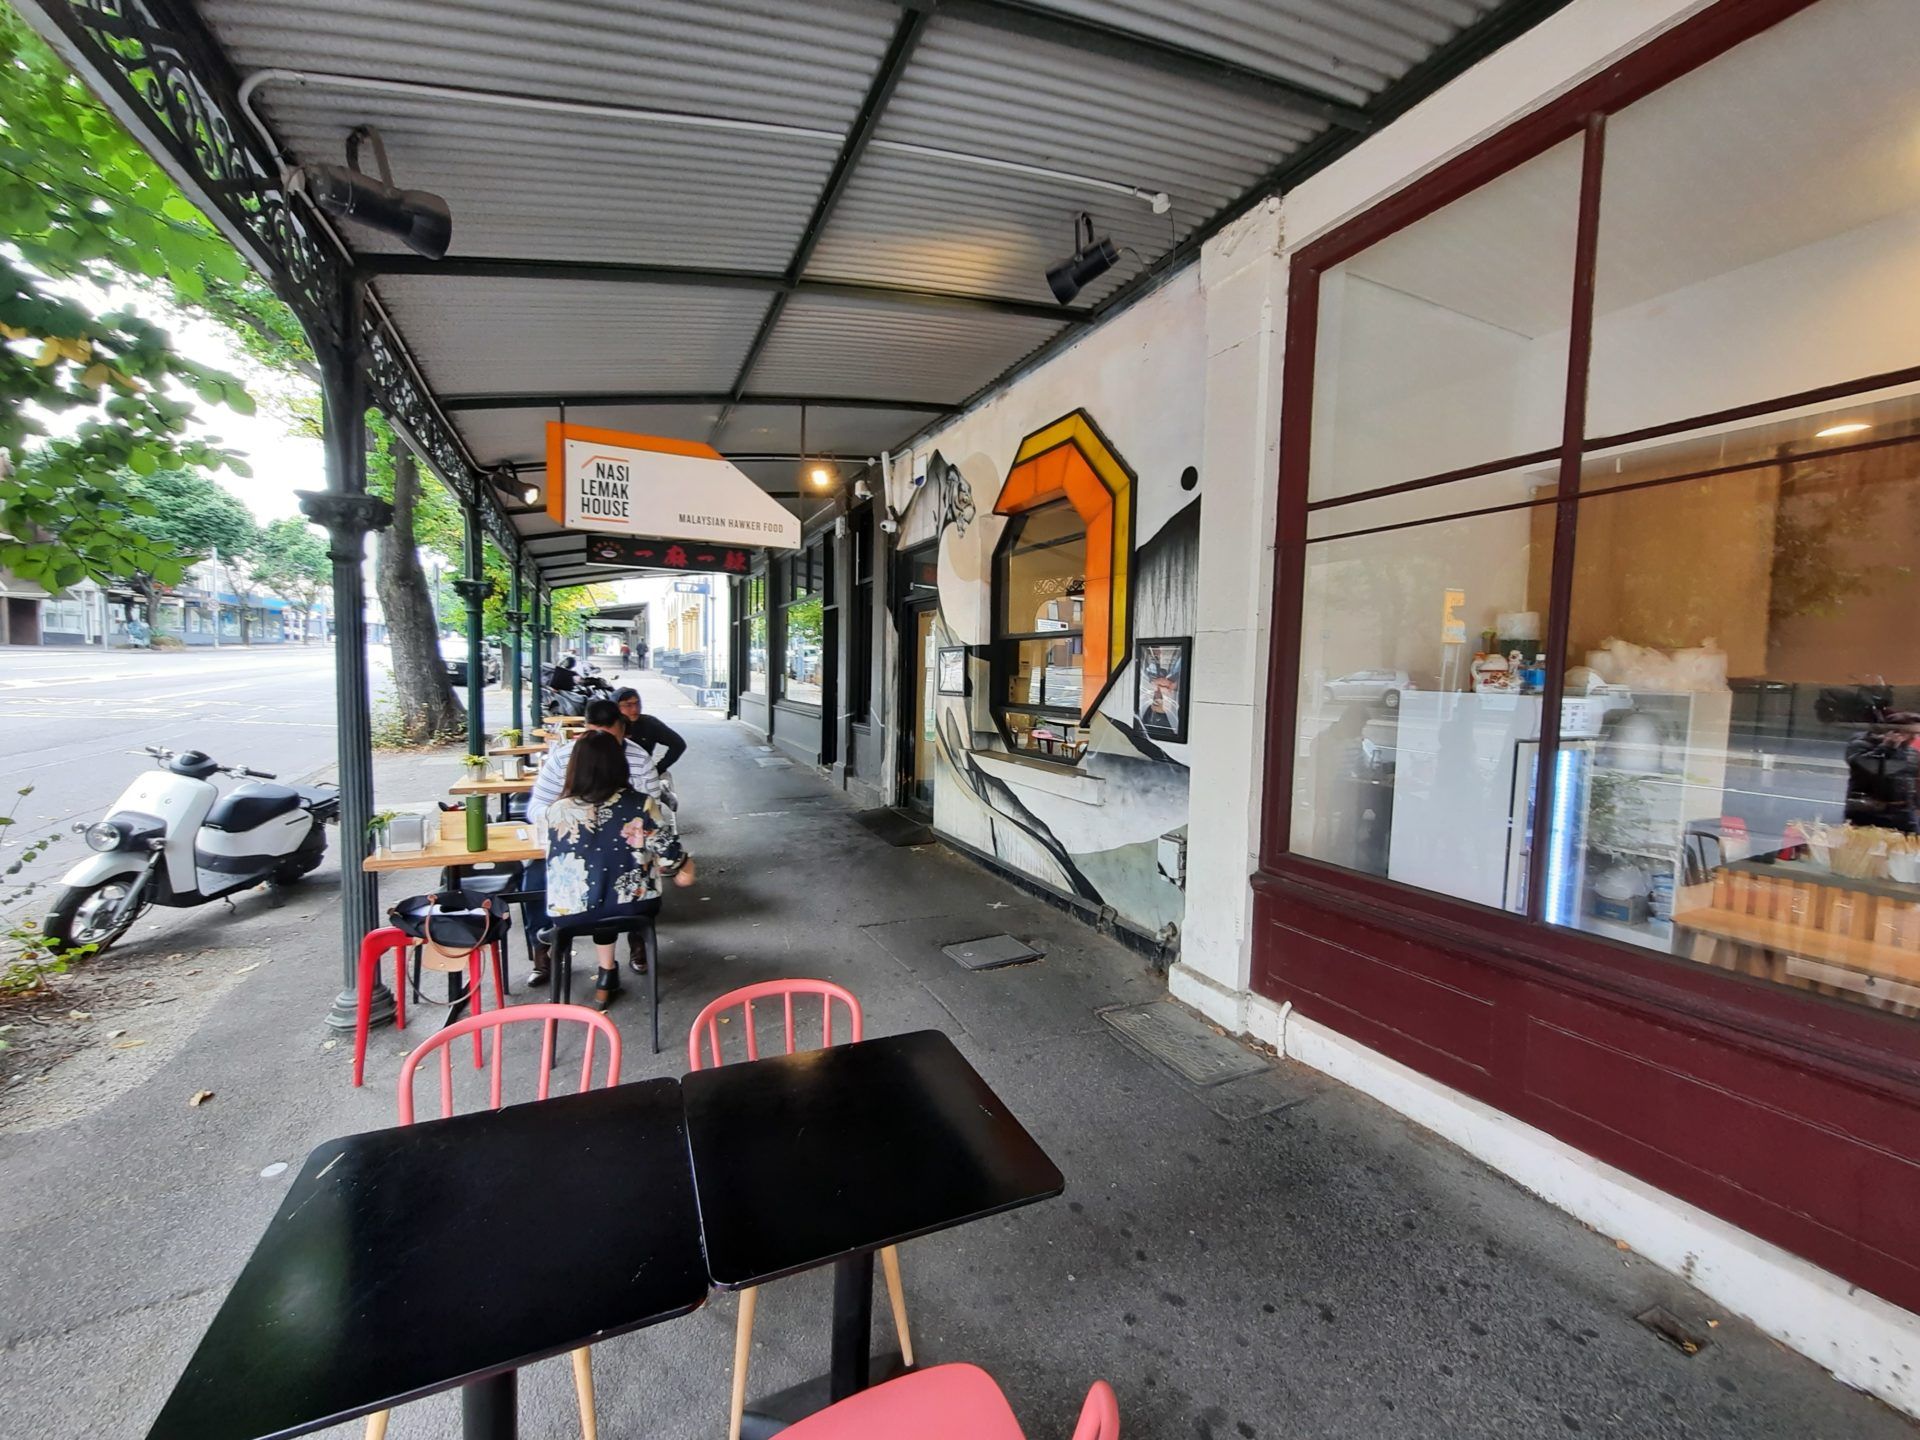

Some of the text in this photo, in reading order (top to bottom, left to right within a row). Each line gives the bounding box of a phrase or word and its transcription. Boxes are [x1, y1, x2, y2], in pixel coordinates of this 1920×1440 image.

[596, 462, 629, 482] NASI
[581, 478, 629, 500] LEMAK
[581, 496, 629, 518] HOUSE
[678, 513, 784, 533] MALAYSIAN HAWKER FOOD
